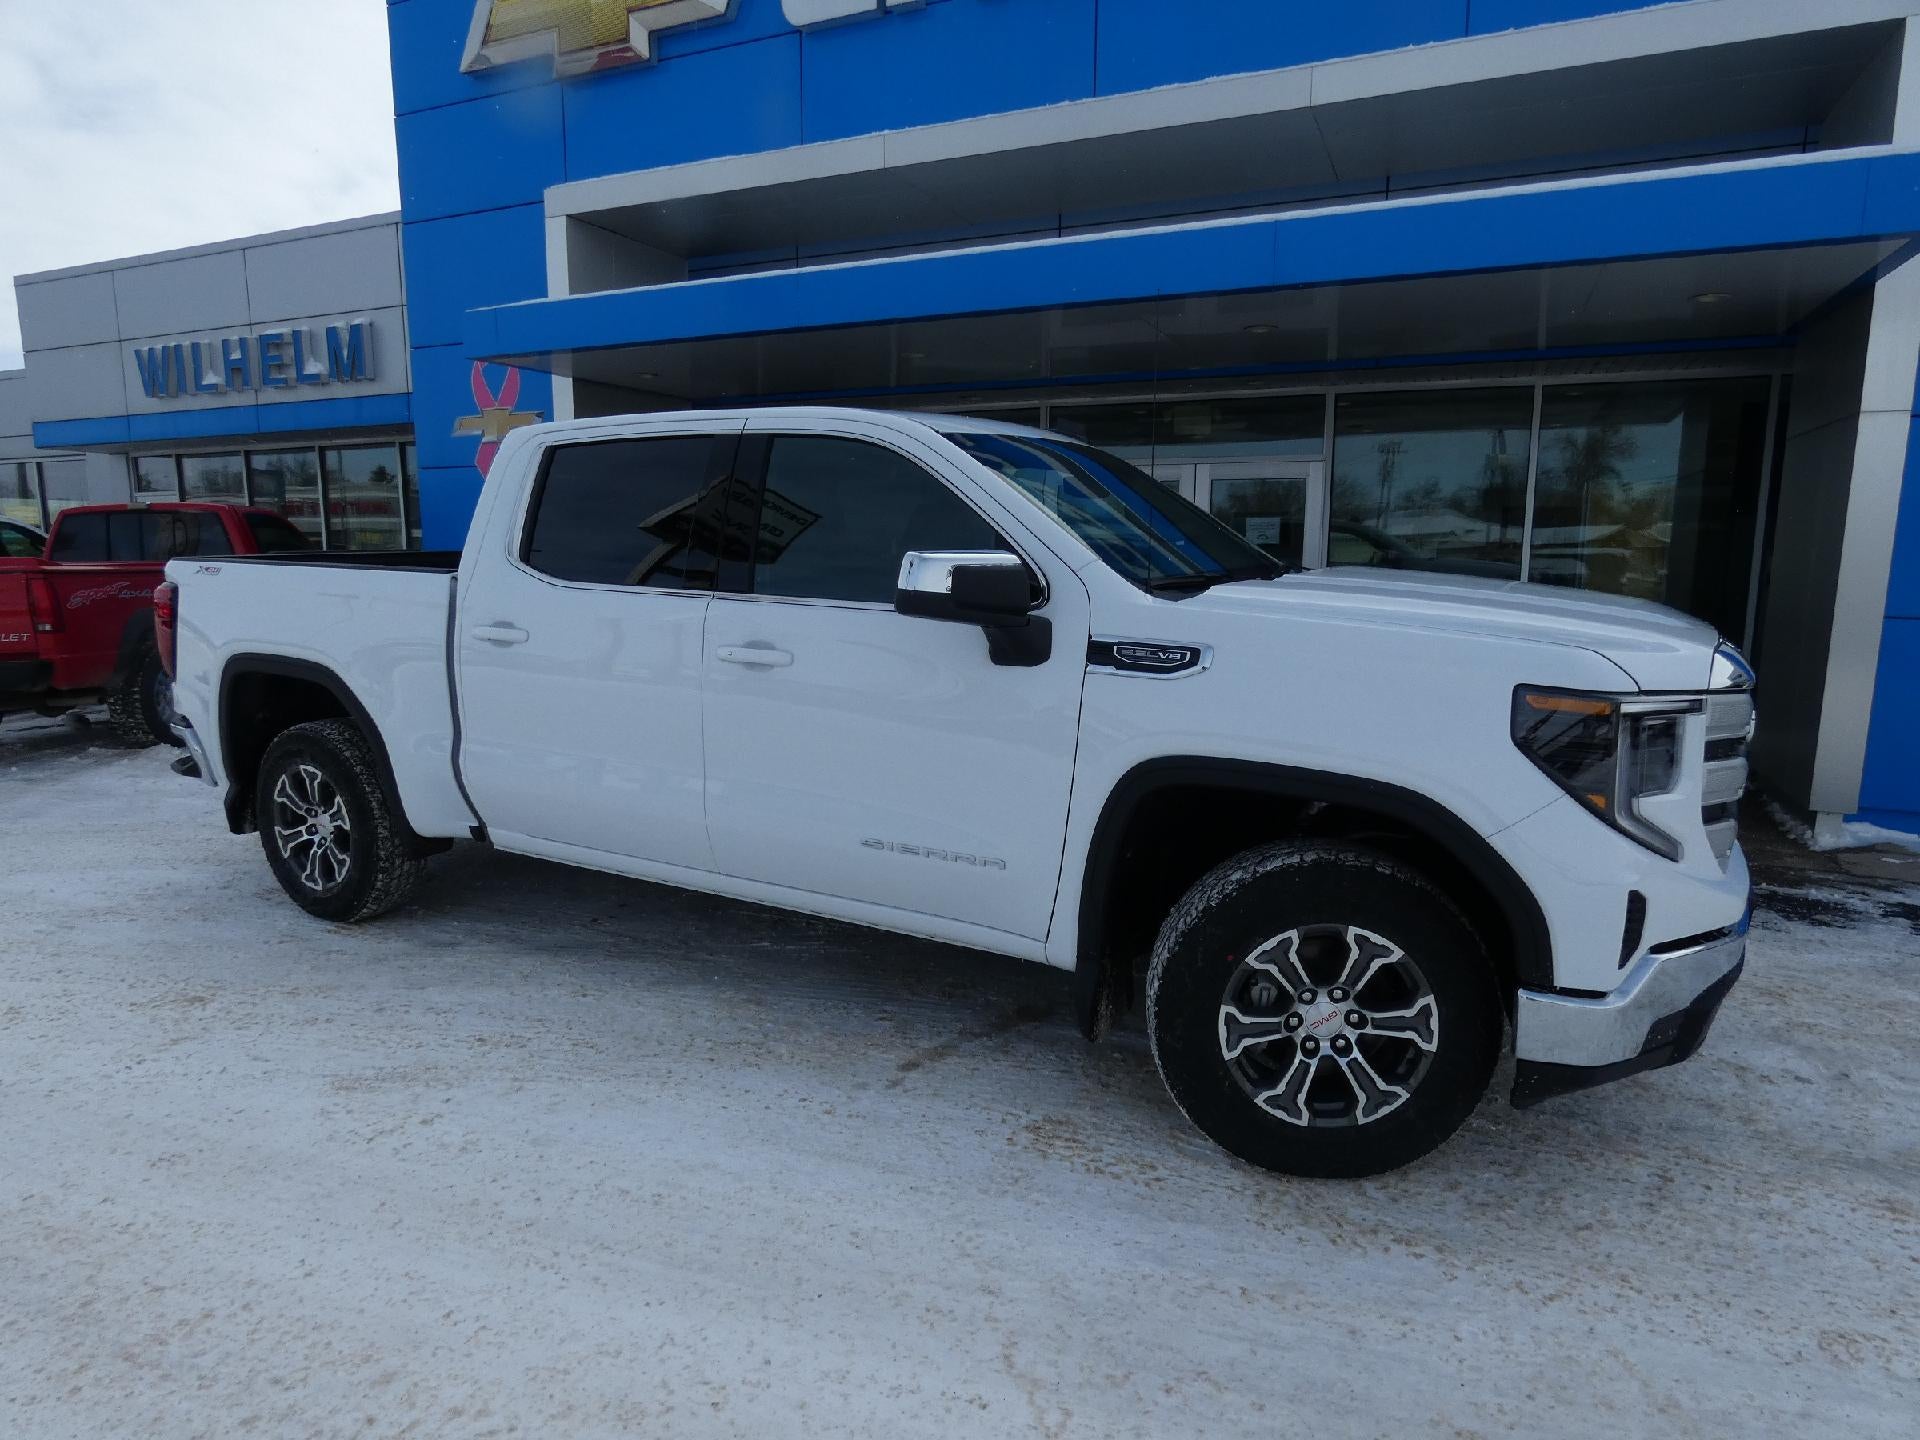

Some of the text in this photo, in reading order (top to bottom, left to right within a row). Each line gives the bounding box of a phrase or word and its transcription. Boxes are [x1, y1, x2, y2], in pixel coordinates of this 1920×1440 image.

[134, 319, 375, 398] WILHELM
[860, 837, 1007, 871] SIERRA
[1309, 1010, 1339, 1030] GMC
